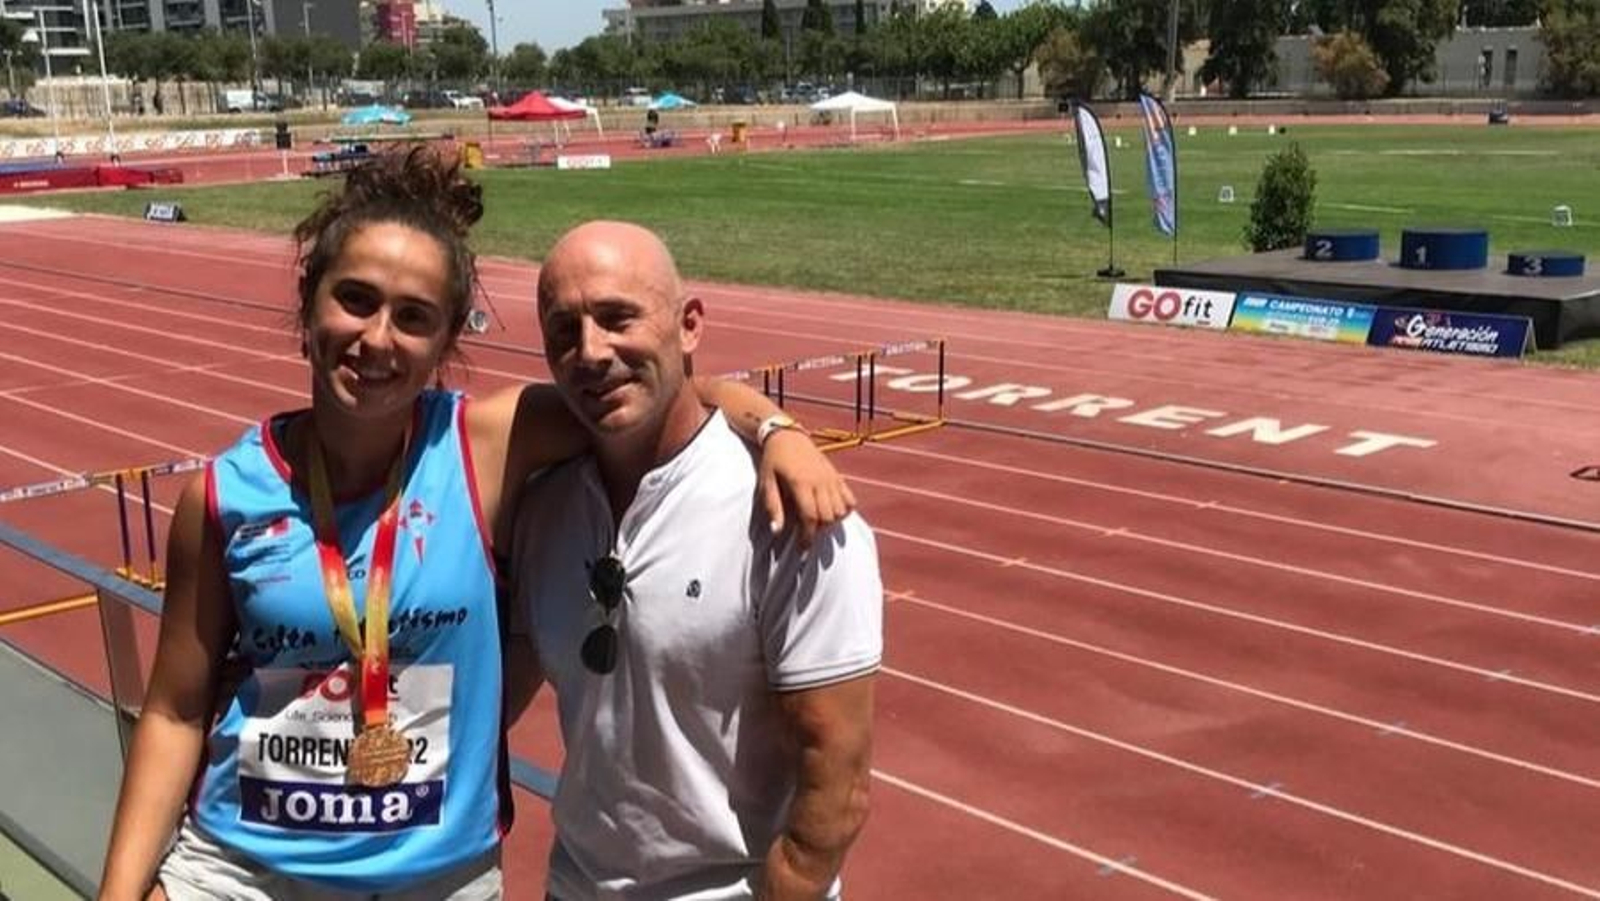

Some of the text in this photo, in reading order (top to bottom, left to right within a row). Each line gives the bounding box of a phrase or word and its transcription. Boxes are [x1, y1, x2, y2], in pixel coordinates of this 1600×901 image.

[1315, 240, 1333, 258] 2
[1416, 246, 1428, 264] 1
[1523, 256, 1543, 275] 3
[829, 363, 1438, 458] TORRENT
[258, 732, 354, 767] TORREN
